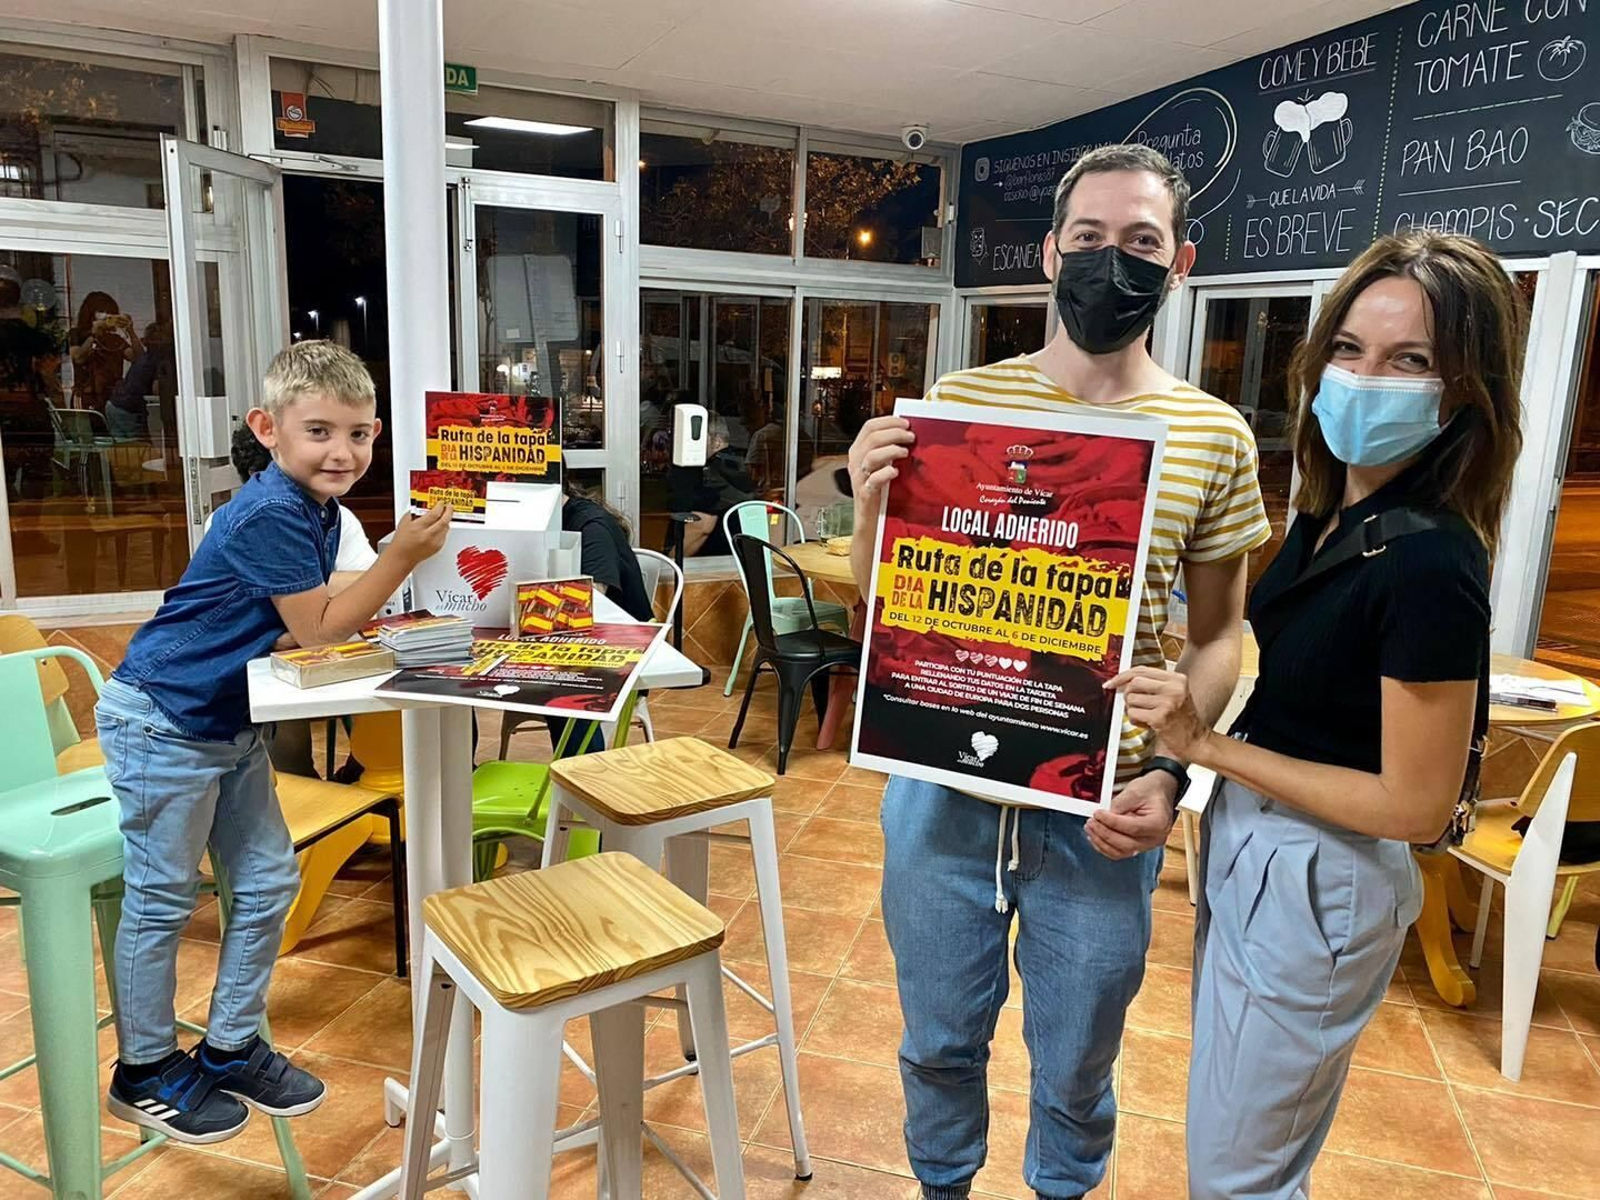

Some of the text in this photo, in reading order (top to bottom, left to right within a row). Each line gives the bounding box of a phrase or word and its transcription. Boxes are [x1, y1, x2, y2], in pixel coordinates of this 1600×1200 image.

[1417, 0, 1508, 48] CARNE
[1326, 32, 1379, 75] BEBE
[1414, 40, 1529, 95] TOMATE
[446, 67, 469, 86] DA
[1137, 122, 1201, 155] Pregunta
[1401, 127, 1529, 177] PAN BAO
[1269, 183, 1336, 209] QUE LA VIDA
[1244, 208, 1356, 258] ES BREVE
[1393, 204, 1517, 240] CHAMPIS
[441, 429, 545, 448] Ruta de la tapa
[459, 445, 545, 464] HISPANIDAD
[976, 482, 1023, 494] Ayuntamiento
[1024, 487, 1033, 496] de
[941, 506, 1079, 549] LOCAL ADHERIDO
[897, 544, 1113, 600] Ruta de la tapa
[891, 591, 923, 609] DE LA
[893, 574, 1108, 638] DIA HISPANIDAD
[472, 641, 509, 650] uta
[515, 643, 542, 652] de
[550, 644, 571, 652] la
[539, 635, 607, 645] ADHERIDO
[889, 612, 1101, 655] DEL 12 DE OCTUBRE AL 6 DE DICIEMBRE
[891, 671, 910, 681] PARA
[911, 675, 938, 686] ENTRAR
[949, 681, 976, 692] SORTEO
[976, 686, 986, 694] DE
[987, 688, 998, 697] UN
[998, 690, 1019, 700] VIAJE
[1019, 694, 1030, 703] DE
[1030, 696, 1042, 705] FIN
[1043, 699, 1054, 708] DE
[1054, 701, 1085, 714] SEMANA
[914, 659, 1063, 692] PARTICIPA CON TU PUNTUACIÓN DE LA TAPA
[920, 669, 1057, 700] RELLENANDO TUS DATOS EN LA TARJETA
[911, 683, 926, 691] UNA
[927, 685, 954, 696] CIUDAD
[954, 691, 964, 699] DE
[965, 692, 994, 704] EUROPA
[994, 698, 1014, 708] PARA
[1014, 702, 1030, 711] DOS
[1030, 704, 1069, 719] PERSONAS
[920, 700, 940, 710] bases
[951, 704, 959, 713] la
[959, 707, 975, 716] web
[976, 710, 988, 720] del
[988, 713, 1040, 730] ayuntamiento
